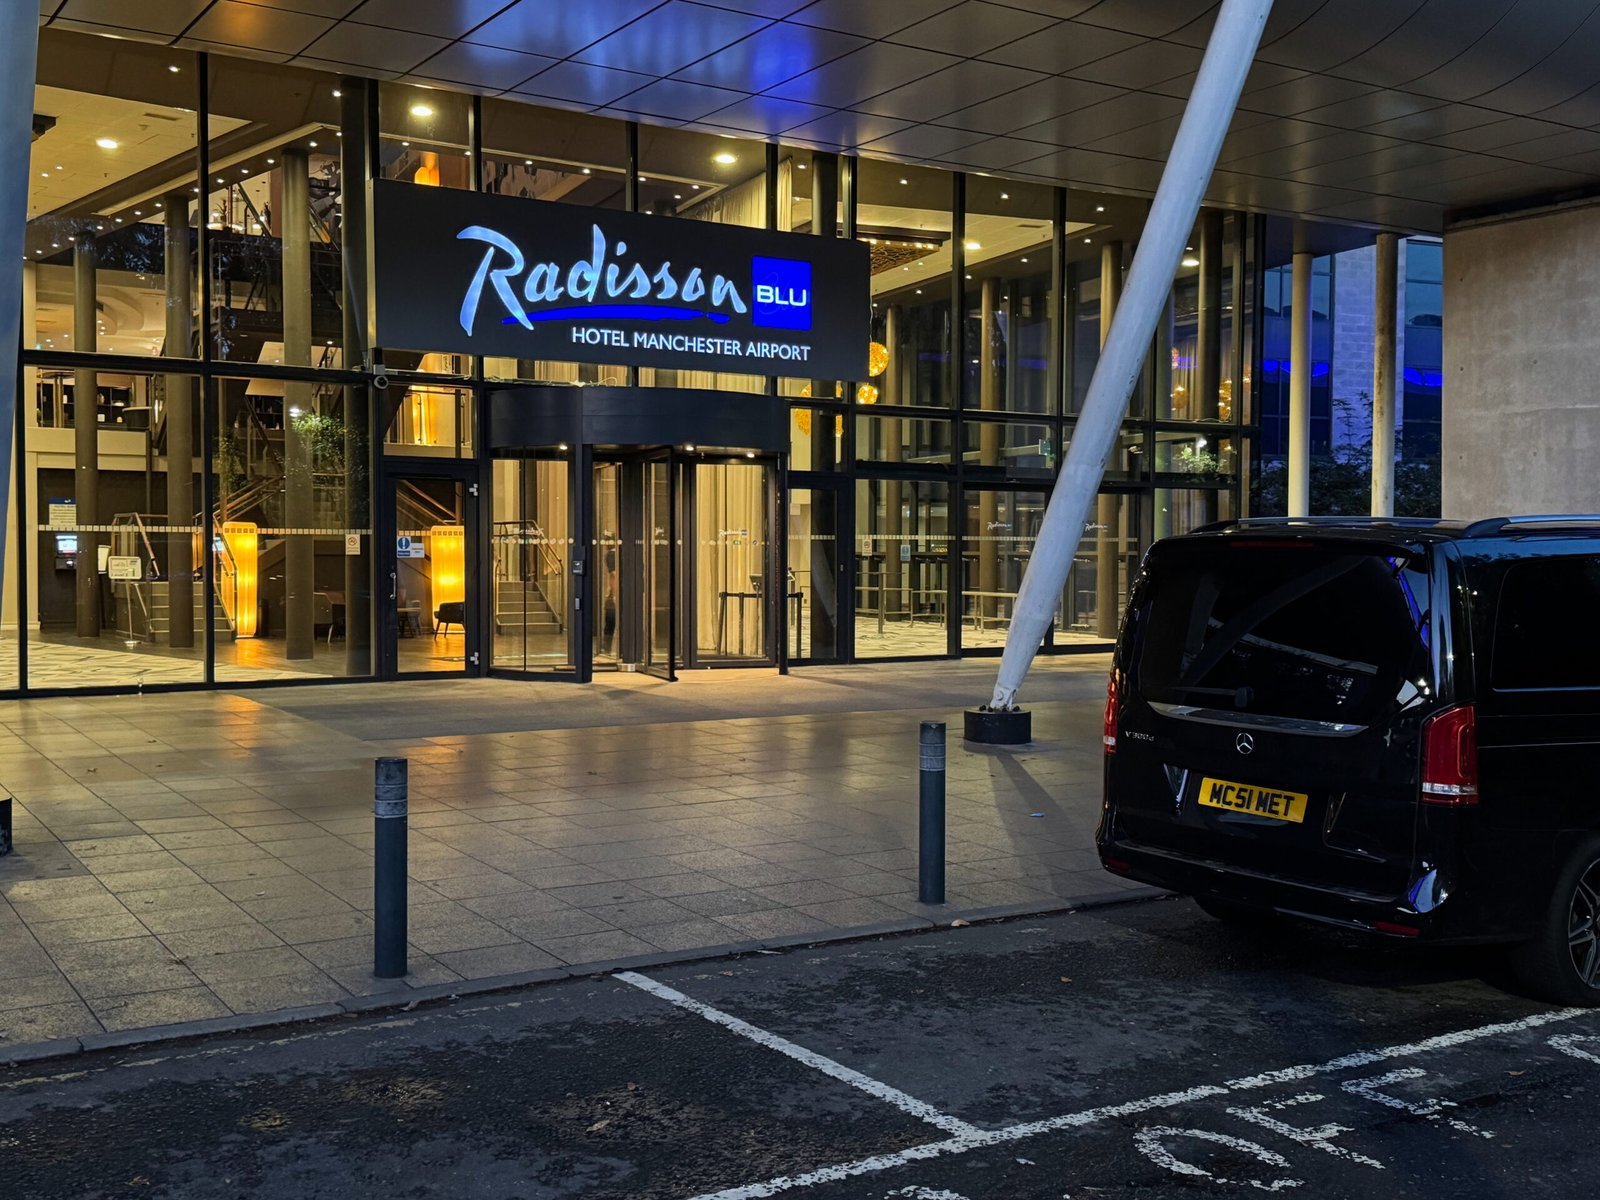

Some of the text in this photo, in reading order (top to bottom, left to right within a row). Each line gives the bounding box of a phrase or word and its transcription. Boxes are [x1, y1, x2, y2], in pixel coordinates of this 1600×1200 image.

[456, 223, 807, 336] Radisson BLU
[572, 326, 811, 361] HOTEL MANCHESTER AIRPORT
[1209, 782, 1254, 809] MC51
